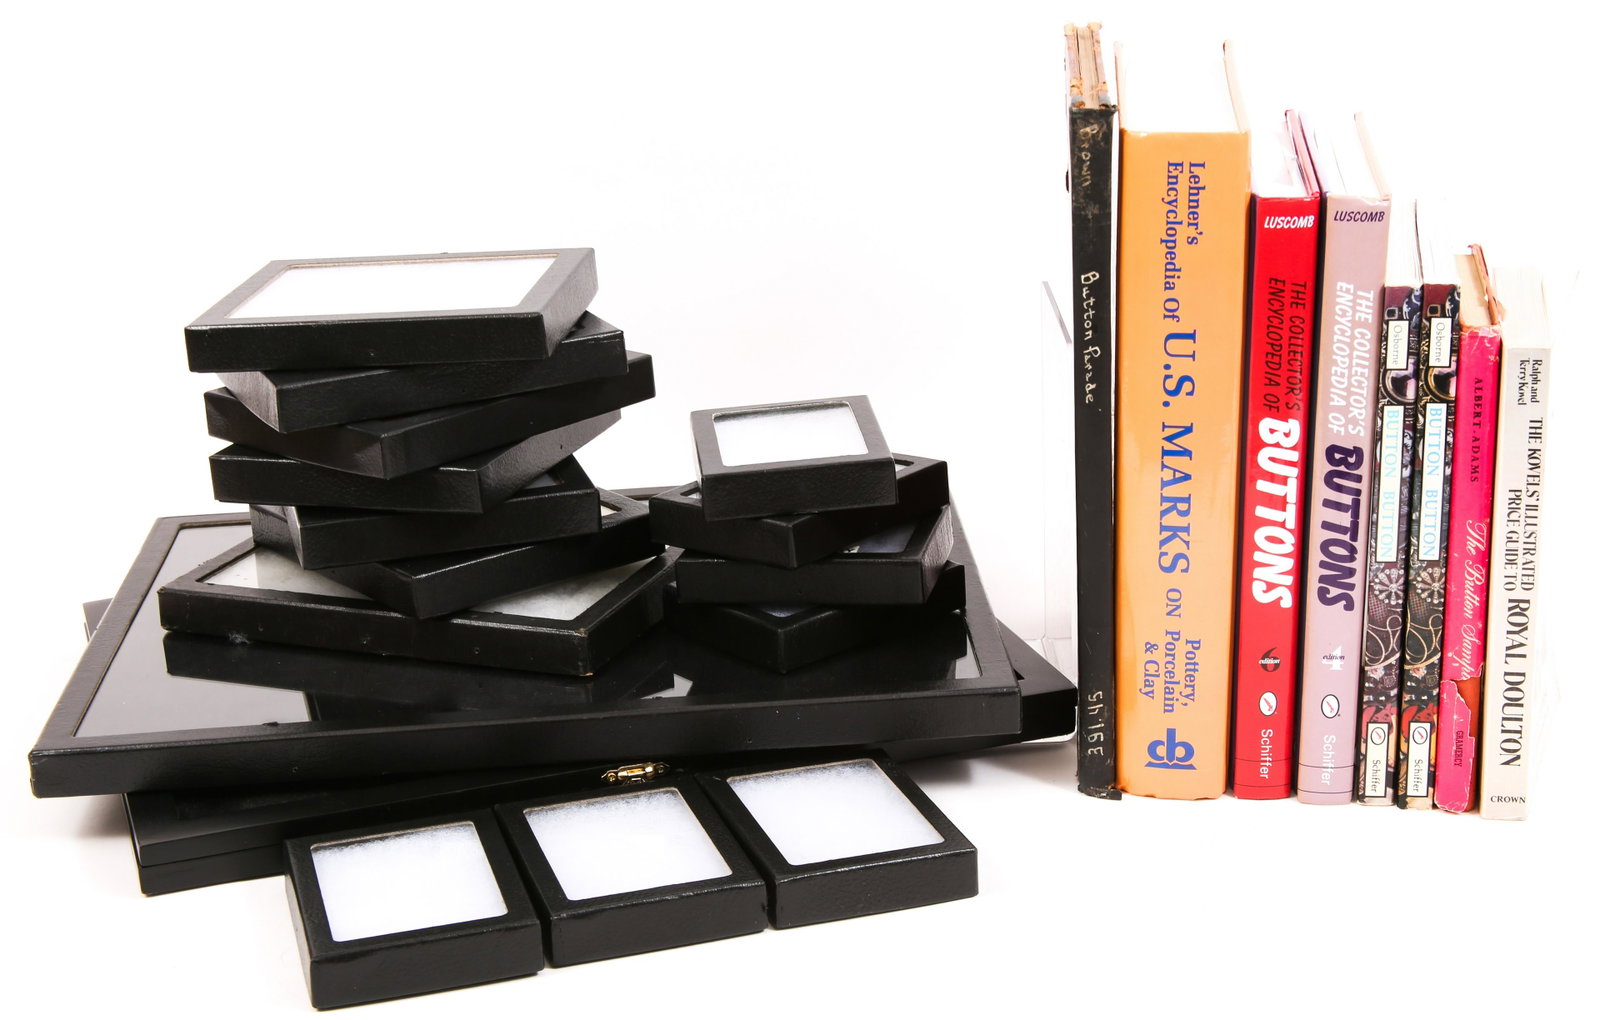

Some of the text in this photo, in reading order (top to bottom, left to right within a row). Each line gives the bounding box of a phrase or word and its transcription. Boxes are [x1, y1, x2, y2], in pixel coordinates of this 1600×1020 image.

[1186, 161, 1205, 245] Lehner's
[1264, 215, 1315, 229] LUSCOMB
[1333, 210, 1385, 223] LUSCOMB
[1081, 271, 1101, 404] Button Parade
[1263, 277, 1286, 413] ENCYCLOPEDIA OF
[1286, 281, 1307, 412] THE COLLECTOR'S
[1328, 281, 1355, 436] ENCYCLOPEDIA OF
[1349, 289, 1374, 438] THE COLLECTOR'S
[1392, 324, 1403, 366] Osborne
[1435, 321, 1446, 363] Osborne
[1158, 161, 1197, 618] Encyclopedia Of U.S. MARKS ON
[1518, 358, 1530, 405] Terry Kovel
[1529, 359, 1543, 403] Ralph and
[1470, 377, 1483, 483] ALBERT ADAMS
[1252, 417, 1300, 608] BUTTONS
[1380, 409, 1400, 558] BUTTON BUTTON
[1423, 407, 1443, 557] BUTTON BUTTON
[1520, 417, 1543, 591] THE KOVELS' ILLUSTRATED
[1317, 444, 1364, 611] BUTTONS
[1466, 520, 1487, 556] The
[1503, 489, 1522, 591] PRICE GUIDE TO
[1464, 560, 1485, 619] Button
[1139, 641, 1160, 700] & Clay
[1163, 630, 1181, 714] Porcelain
[1180, 639, 1201, 707] Pottery,
[1322, 653, 1345, 661] edition
[1499, 598, 1531, 767] ROYAL DOULTON
[1260, 729, 1273, 779] Schiffer
[1321, 735, 1336, 785] Schiffer
[1371, 759, 1381, 793] Schiffer
[1413, 759, 1423, 792] Schiffer
[1454, 730, 1464, 768] GRAMERCY
[1490, 795, 1526, 804] CROWN
